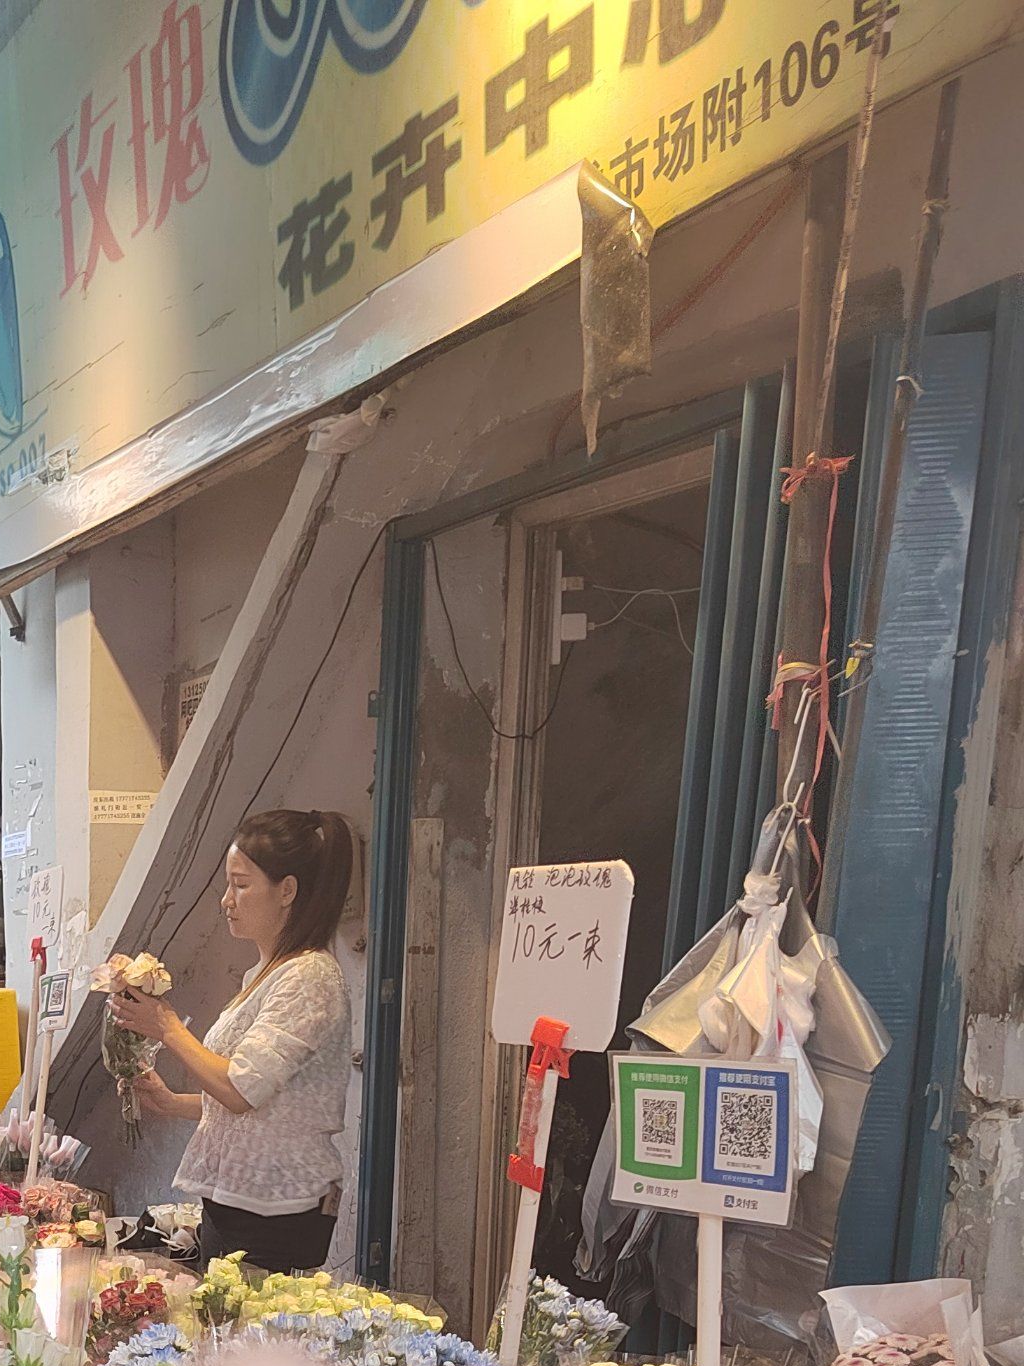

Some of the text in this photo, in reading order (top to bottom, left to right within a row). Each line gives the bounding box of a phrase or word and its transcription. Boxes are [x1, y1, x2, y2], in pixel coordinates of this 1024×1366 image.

[592, 0, 901, 200] 市场附106号
[49, 0, 212, 299] 玫瑰
[183, 680, 210, 699] 131250
[511, 919, 603, 970] 10元一束
[646, 1184, 679, 1199] 微信支付
[735, 1197, 759, 1210] 支付宝
